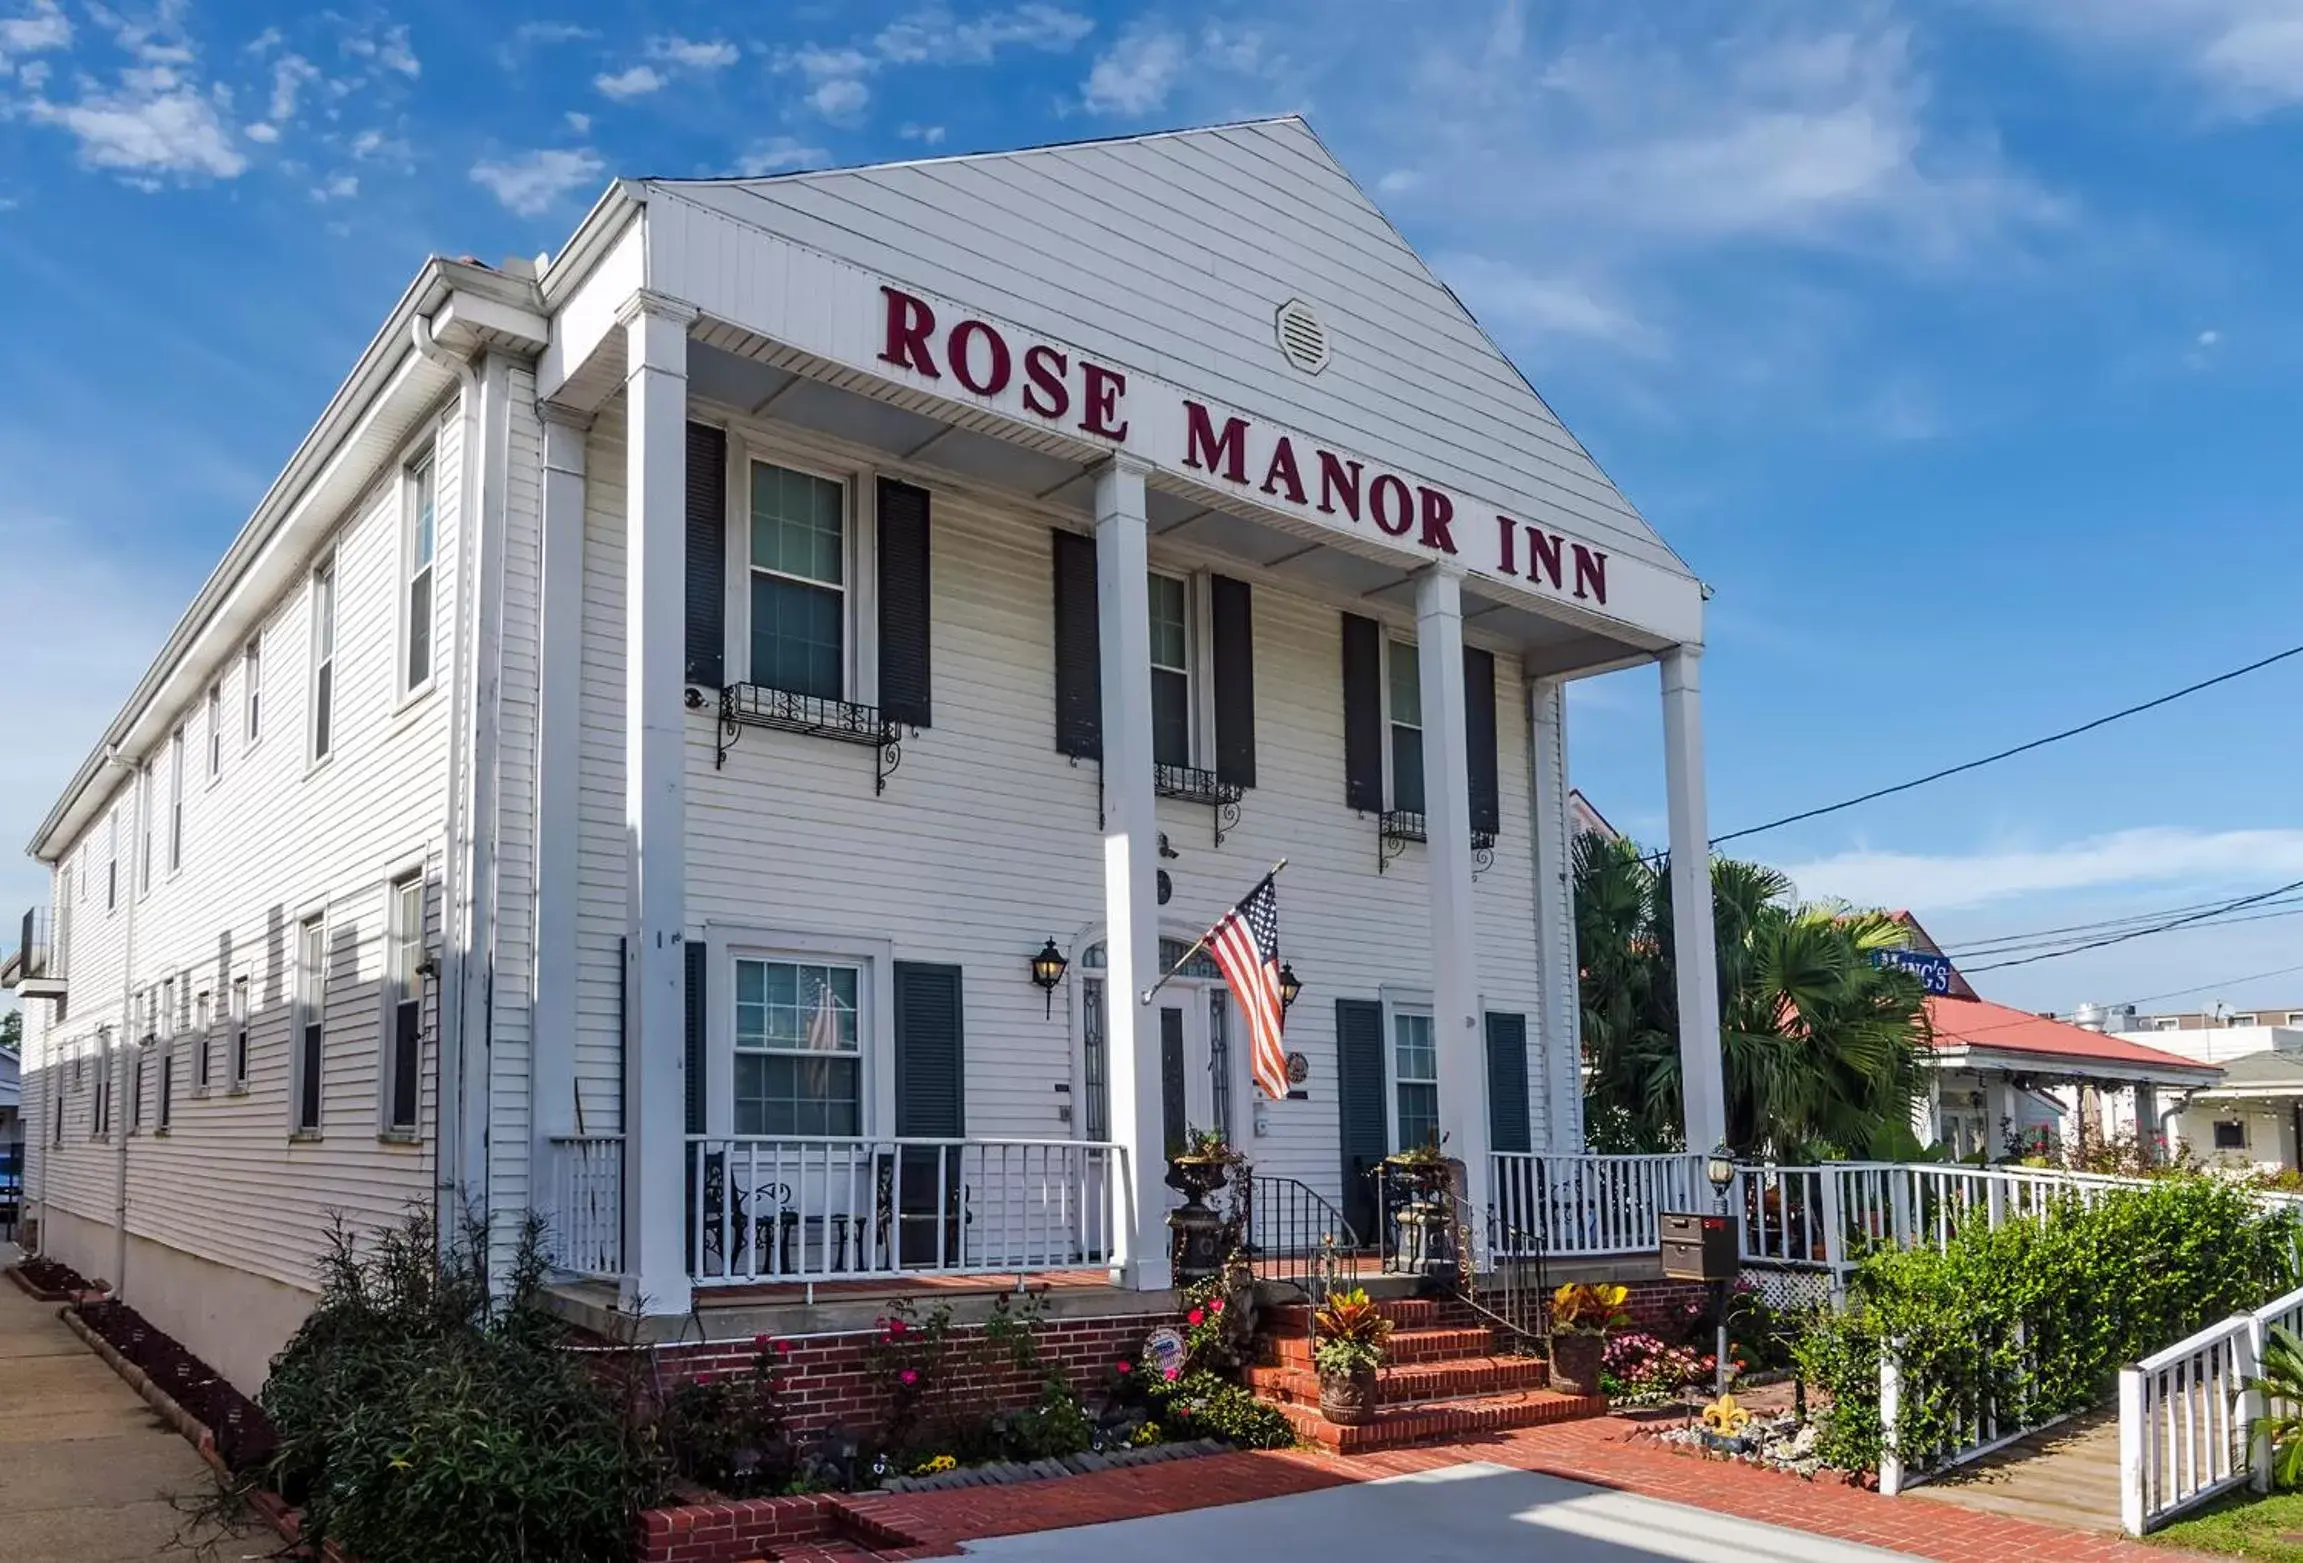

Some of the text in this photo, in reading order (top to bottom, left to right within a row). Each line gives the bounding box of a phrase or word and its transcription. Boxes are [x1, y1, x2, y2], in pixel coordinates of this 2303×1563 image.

[878, 286, 1609, 605] ROSE MANOR INN
